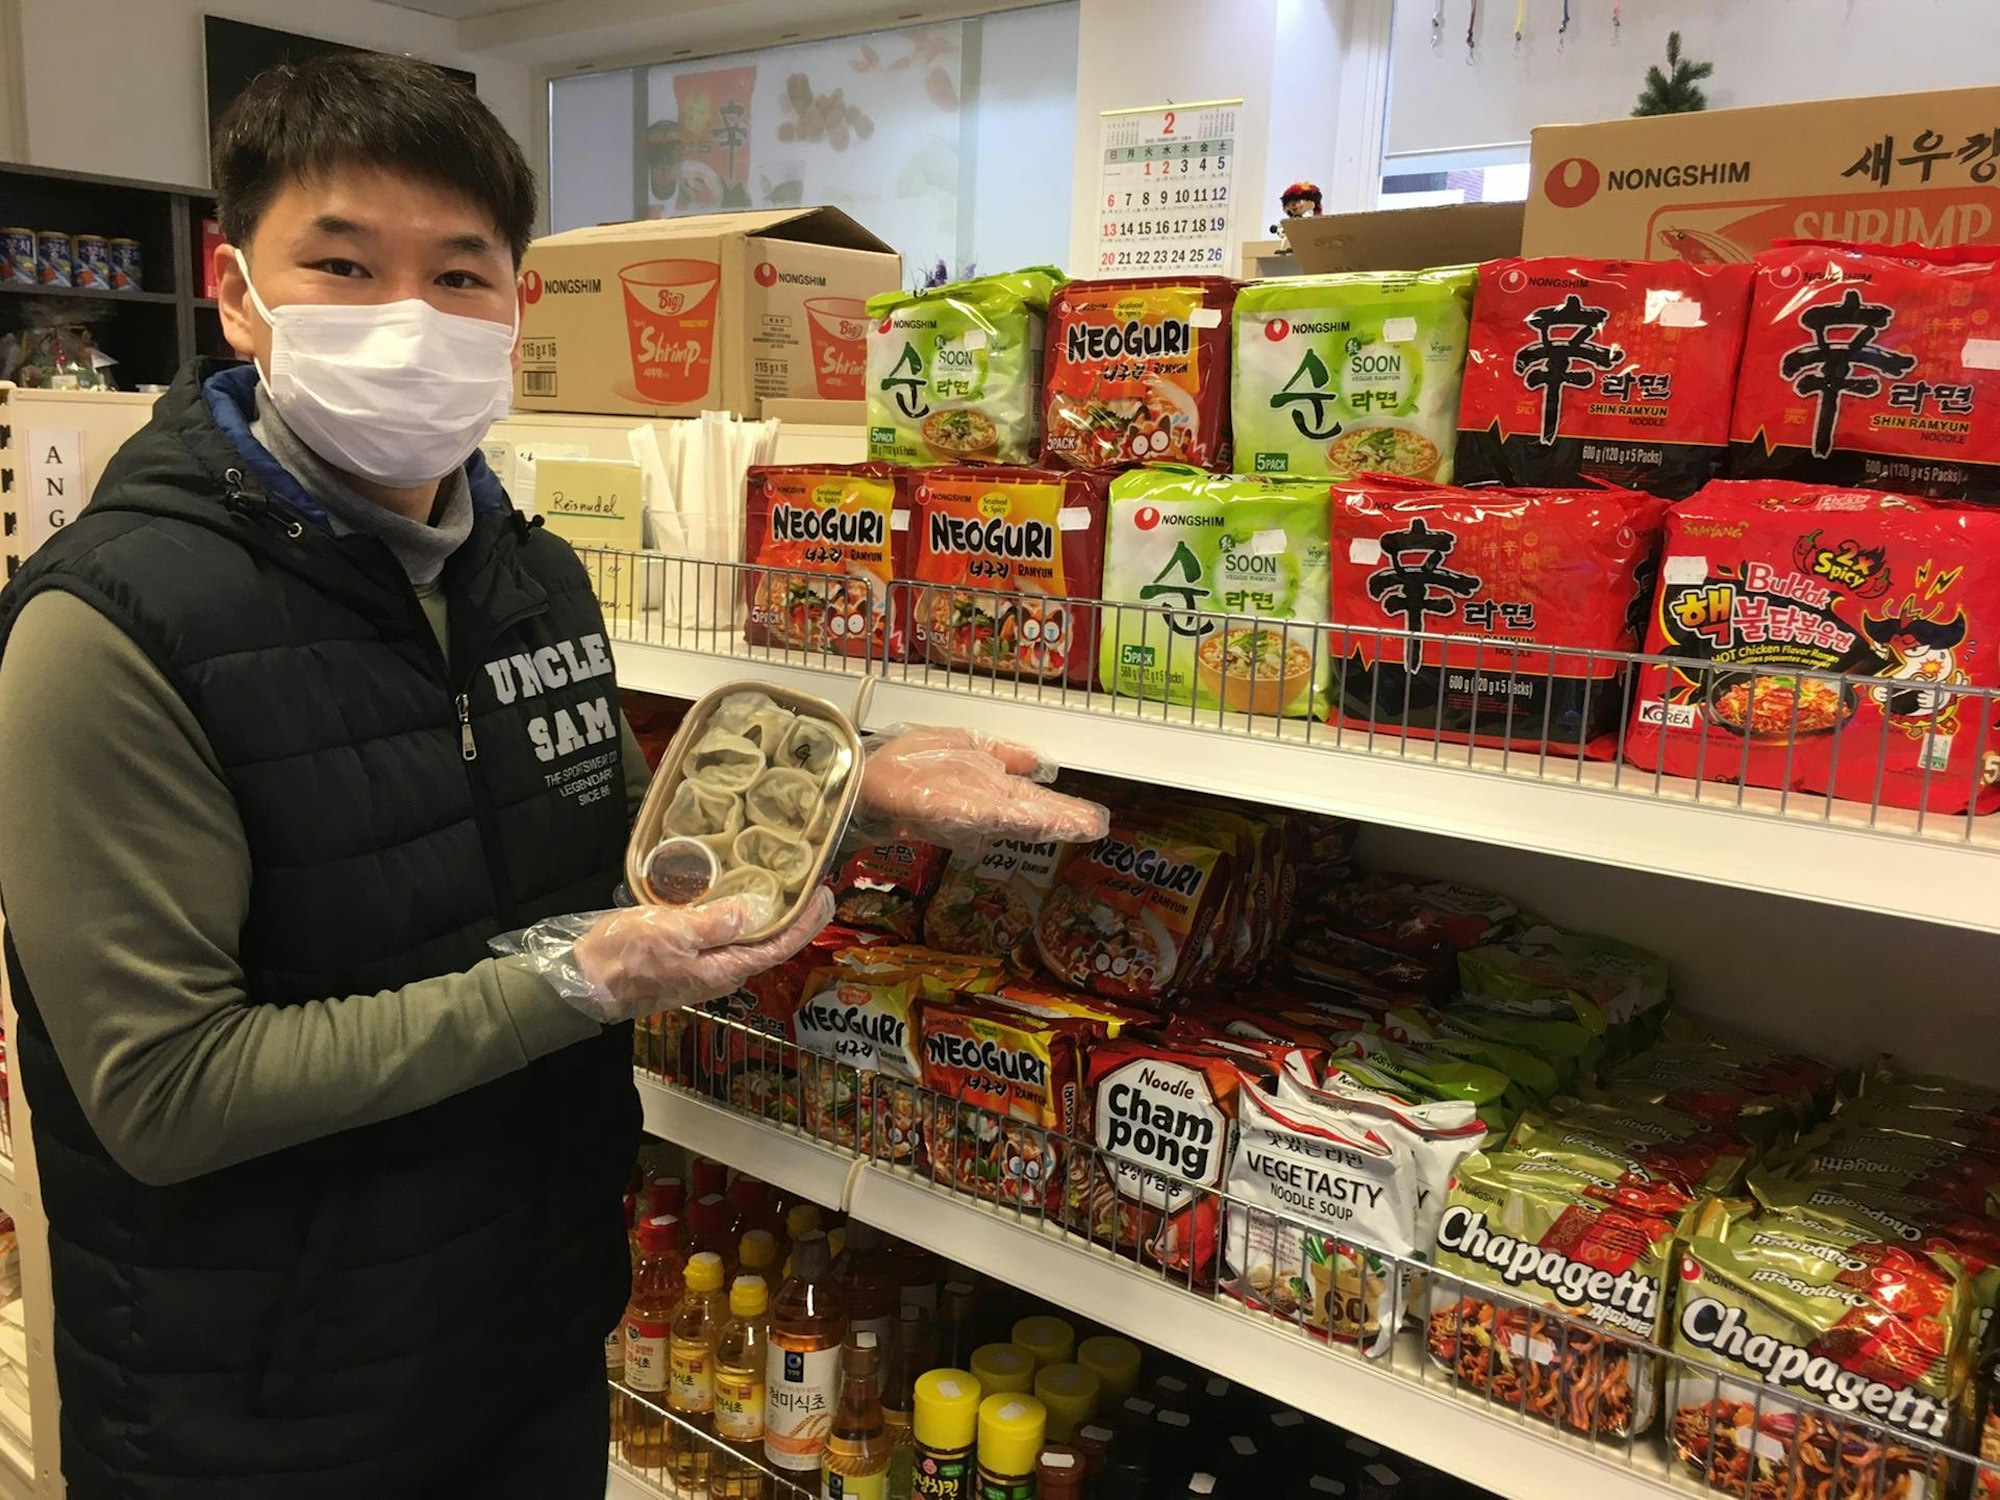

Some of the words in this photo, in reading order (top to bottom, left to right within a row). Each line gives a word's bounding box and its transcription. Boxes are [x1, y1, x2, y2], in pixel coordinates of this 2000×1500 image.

[1163, 112, 1175, 134] 2
[1145, 162, 1151, 175] 1
[1162, 161, 1170, 174] 2
[1180, 160, 1188, 173] 3
[1199, 158, 1207, 171] 4
[1218, 156, 1225, 170] 5
[1607, 160, 1750, 191] NONGSHIM
[1107, 194, 1115, 207] 6
[1125, 193, 1132, 206] 7
[1142, 192, 1150, 205] 8
[1160, 191, 1167, 204] 9
[1175, 189, 1190, 203] 10
[1193, 189, 1207, 202] 11
[1211, 187, 1227, 201] 12
[1103, 223, 1117, 237] 13
[1120, 222, 1134, 235] 14
[1137, 221, 1151, 234] 15
[1155, 221, 1170, 234] 16
[1173, 220, 1188, 233] 17
[1191, 219, 1206, 232] 18
[1209, 217, 1225, 231] 19
[1793, 203, 1992, 248] SHRIMP
[1101, 252, 1115, 265] 20
[1118, 252, 1132, 265] 21
[1136, 251, 1150, 264] 22
[1153, 250, 1168, 263] 23
[1171, 250, 1185, 262] 24
[1189, 249, 1204, 262] 25
[1207, 248, 1222, 261] 26
[544, 278, 601, 295] NONGSHIM
[778, 272, 827, 288] NONGSHIM
[1528, 277, 1589, 289] NONGSHIM
[658, 290, 685, 312] Big
[840, 320, 863, 338] Big
[893, 319, 937, 330] NONGSHIM
[1292, 321, 1350, 335] NONGSHIM
[637, 327, 701, 377] Shrimp
[1068, 320, 1189, 362] NEOGURI
[755, 362, 769, 373] 115
[821, 346, 867, 386] Shrim
[938, 350, 973, 366] SOON
[1351, 355, 1401, 374] SOON
[1514, 295, 1625, 445] 辛
[881, 341, 930, 419] 순
[1782, 289, 1917, 458] 辛
[936, 379, 970, 396] 라면
[1270, 349, 1342, 439] 순
[1602, 373, 1671, 402] 라면
[1890, 381, 1974, 414] 라면
[1351, 390, 1398, 411] 라면
[1589, 403, 1617, 414] SHIN
[1618, 404, 1668, 417] RAMYUN
[1628, 417, 1665, 427] NOODLE
[1872, 415, 1907, 427] SHIN
[1908, 417, 1969, 432] RAMYUN
[1920, 432, 1966, 444] NOODLE
[1257, 455, 1286, 471] 5PACK
[552, 492, 617, 516] Reisnudel
[982, 497, 1008, 506] Seafood
[774, 505, 883, 545] NEOGURI
[1161, 515, 1225, 527] NONGSHIM
[1683, 522, 1743, 538] SAMYANG
[932, 514, 1052, 558] NEOGURI
[851, 549, 882, 562] RAMYUN
[1225, 555, 1276, 574] SOON
[970, 560, 1009, 579] 너구리
[1018, 564, 1053, 578] RAMYUN
[1814, 551, 1866, 588] Spicy
[1140, 541, 1214, 636] 순
[1369, 519, 1481, 675] 辛
[1746, 562, 1830, 610] Buldak
[1225, 590, 1275, 612] 라면
[1464, 601, 1536, 629] 라면
[1672, 584, 1735, 647] 핵
[1495, 647, 1533, 658] NOOLE
[1711, 649, 1738, 664] HOT
[1738, 644, 1780, 657] Chicken
[1782, 645, 1810, 656] Flavor
[484, 633, 612, 705] UNCLE
[1642, 704, 1691, 726] KOREA
[527, 696, 616, 762] SAM
[544, 772, 563, 788] THE
[559, 768, 614, 797] LEGENDAR
[1090, 837, 1203, 898] NEOGURI
[1151, 890, 1188, 915] RAMYUN
[800, 1002, 905, 1046] NEOGURI
[927, 1033, 1046, 1086] NEOGURI
[1139, 1067, 1194, 1099] Noodle
[1108, 1083, 1213, 1144] Cham
[1106, 1117, 1211, 1179] pong
[1247, 1150, 1383, 1208] VEGETASTY
[1270, 1182, 1315, 1211] NOODLE
[1320, 1194, 1353, 1221] SOUP
[1808, 1191, 1922, 1242] Chapagetti
[1438, 1205, 1660, 1319] Chapagetti
[1681, 1297, 1949, 1437] Chapagetti
[769, 1386, 826, 1414] 현미식초
